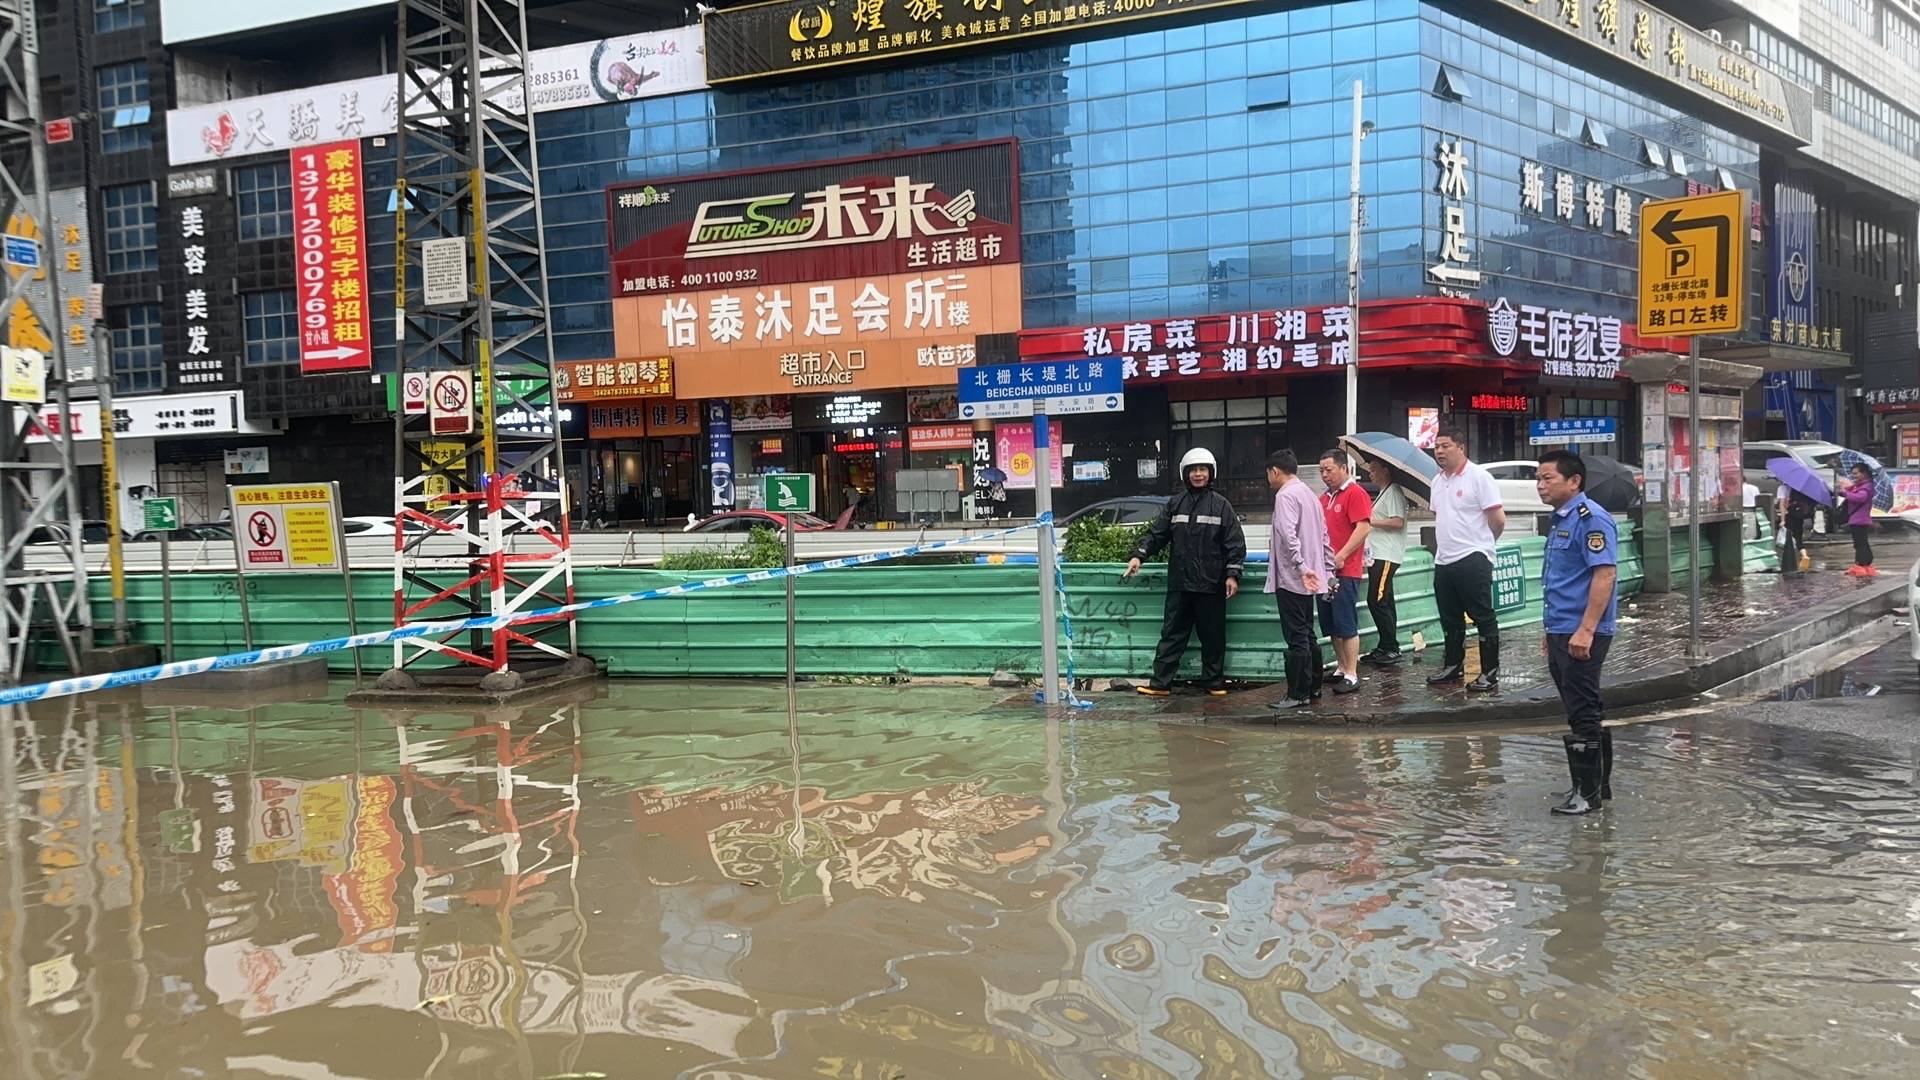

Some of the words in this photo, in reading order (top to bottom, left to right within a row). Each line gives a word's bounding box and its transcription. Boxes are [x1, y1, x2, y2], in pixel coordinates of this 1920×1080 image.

[791, 39, 870, 62] 餐饮品牌加盟
[877, 29, 933, 49] 品牌孵化
[941, 18, 1012, 40] 美食城运营
[618, 193, 646, 209] 祥顺
[652, 192, 671, 204] 未来
[802, 177, 938, 240] 未来
[1439, 140, 1471, 263] 沐足
[1522, 161, 1651, 236] 斯博特健
[300, 154, 328, 330] 13712000769
[325, 149, 363, 343] 豪华装修写字楼招租
[907, 234, 1003, 267] 生活超市
[1671, 249, 1690, 276] P
[181, 206, 210, 356] 美容美发
[680, 274, 703, 286] 400
[705, 270, 733, 283] 1100
[735, 268, 757, 281] 932
[1651, 279, 1709, 293] 北栅长堤北路
[1653, 290, 1707, 303] 32号-停车场
[662, 276, 948, 347] 怡泰沐足会所
[946, 274, 971, 327] 二楼
[1648, 304, 1728, 327] 路口左转
[305, 329, 330, 346] 甘小姐
[1083, 318, 1197, 357] 私房菜
[1227, 305, 1350, 345] 川湘菜
[1520, 304, 1624, 362] 毛府家宴
[1770, 317, 1842, 352] 东方商业大厦
[779, 349, 866, 376] 超市入口
[917, 343, 976, 368] 欧芭莎
[1222, 340, 1350, 373] 湘约毛府
[575, 360, 658, 387] 智能钢琴
[792, 373, 853, 387] ENTRANCE
[975, 362, 1104, 387] 北栅长堤北路
[986, 386, 1073, 399] BEICECHANGDIBEI
[1078, 382, 1093, 392] LU
[591, 406, 641, 428] 斯博特
[653, 404, 689, 426] 健身
[1013, 458, 1030, 471] 5折
[216, 656, 253, 669] POLICE
[308, 643, 341, 655] POLICE
